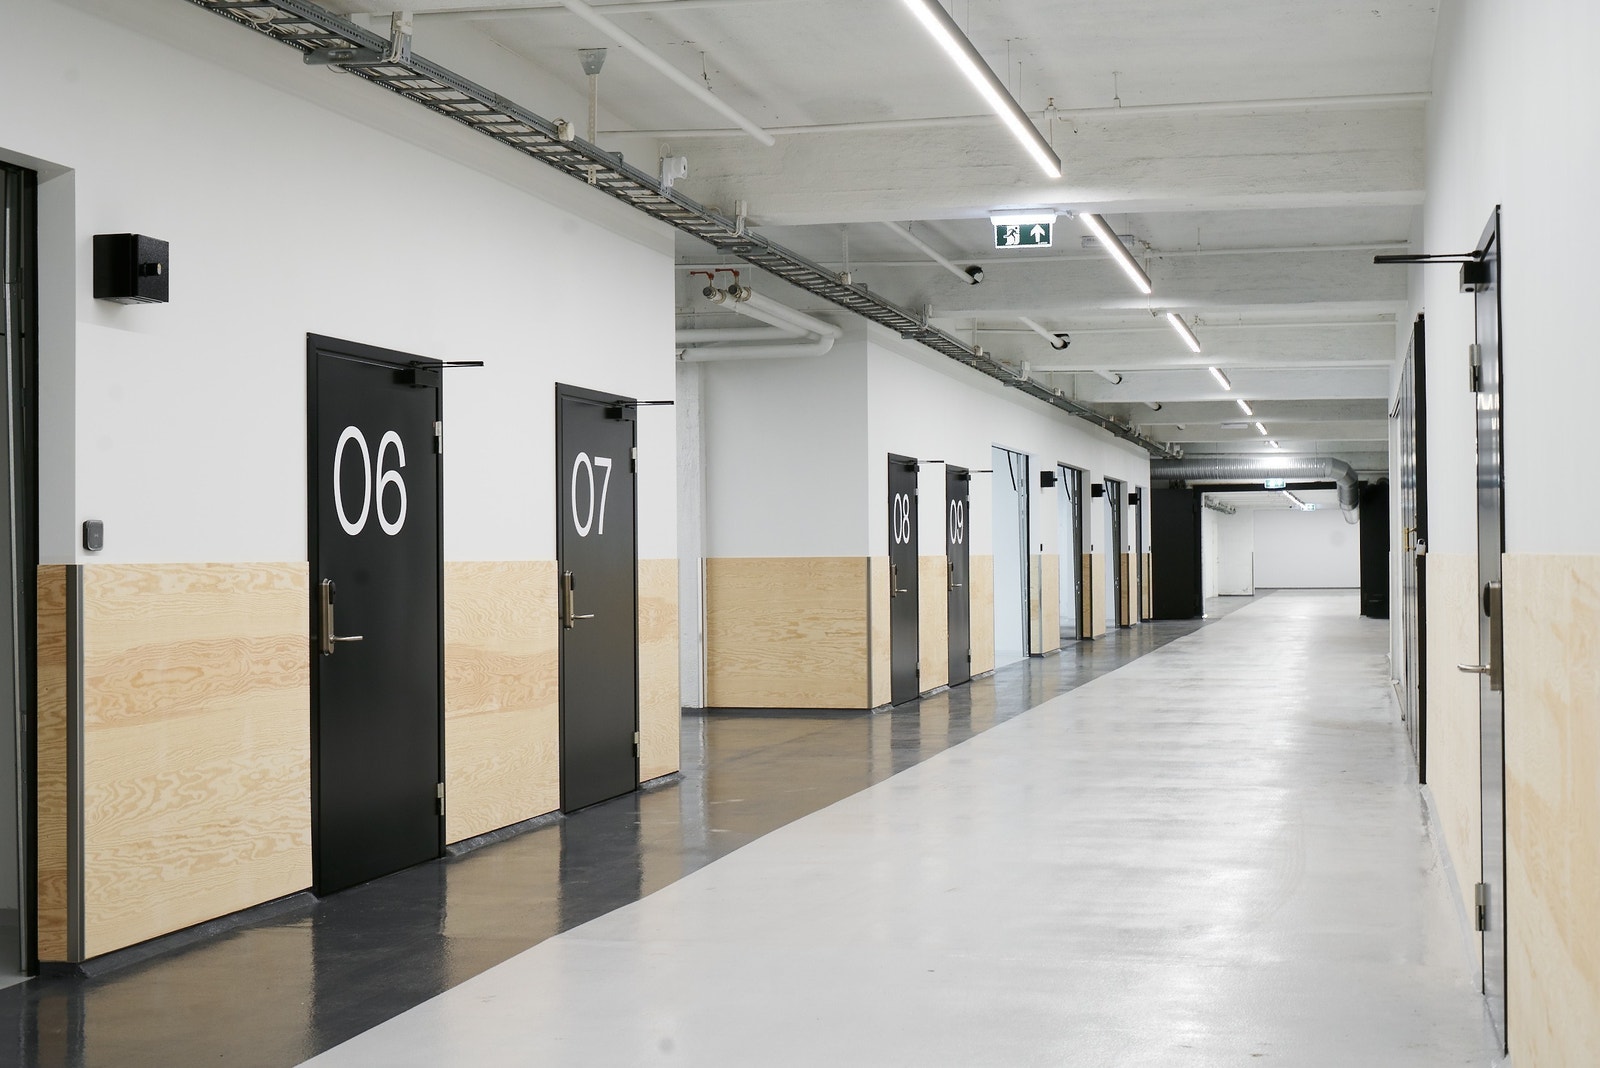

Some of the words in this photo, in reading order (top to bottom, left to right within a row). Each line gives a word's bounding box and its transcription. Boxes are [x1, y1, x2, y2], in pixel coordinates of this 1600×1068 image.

[333, 425, 408, 536] 06
[571, 451, 613, 538] 07
[893, 493, 911, 545] 08
[950, 499, 964, 545] 09
